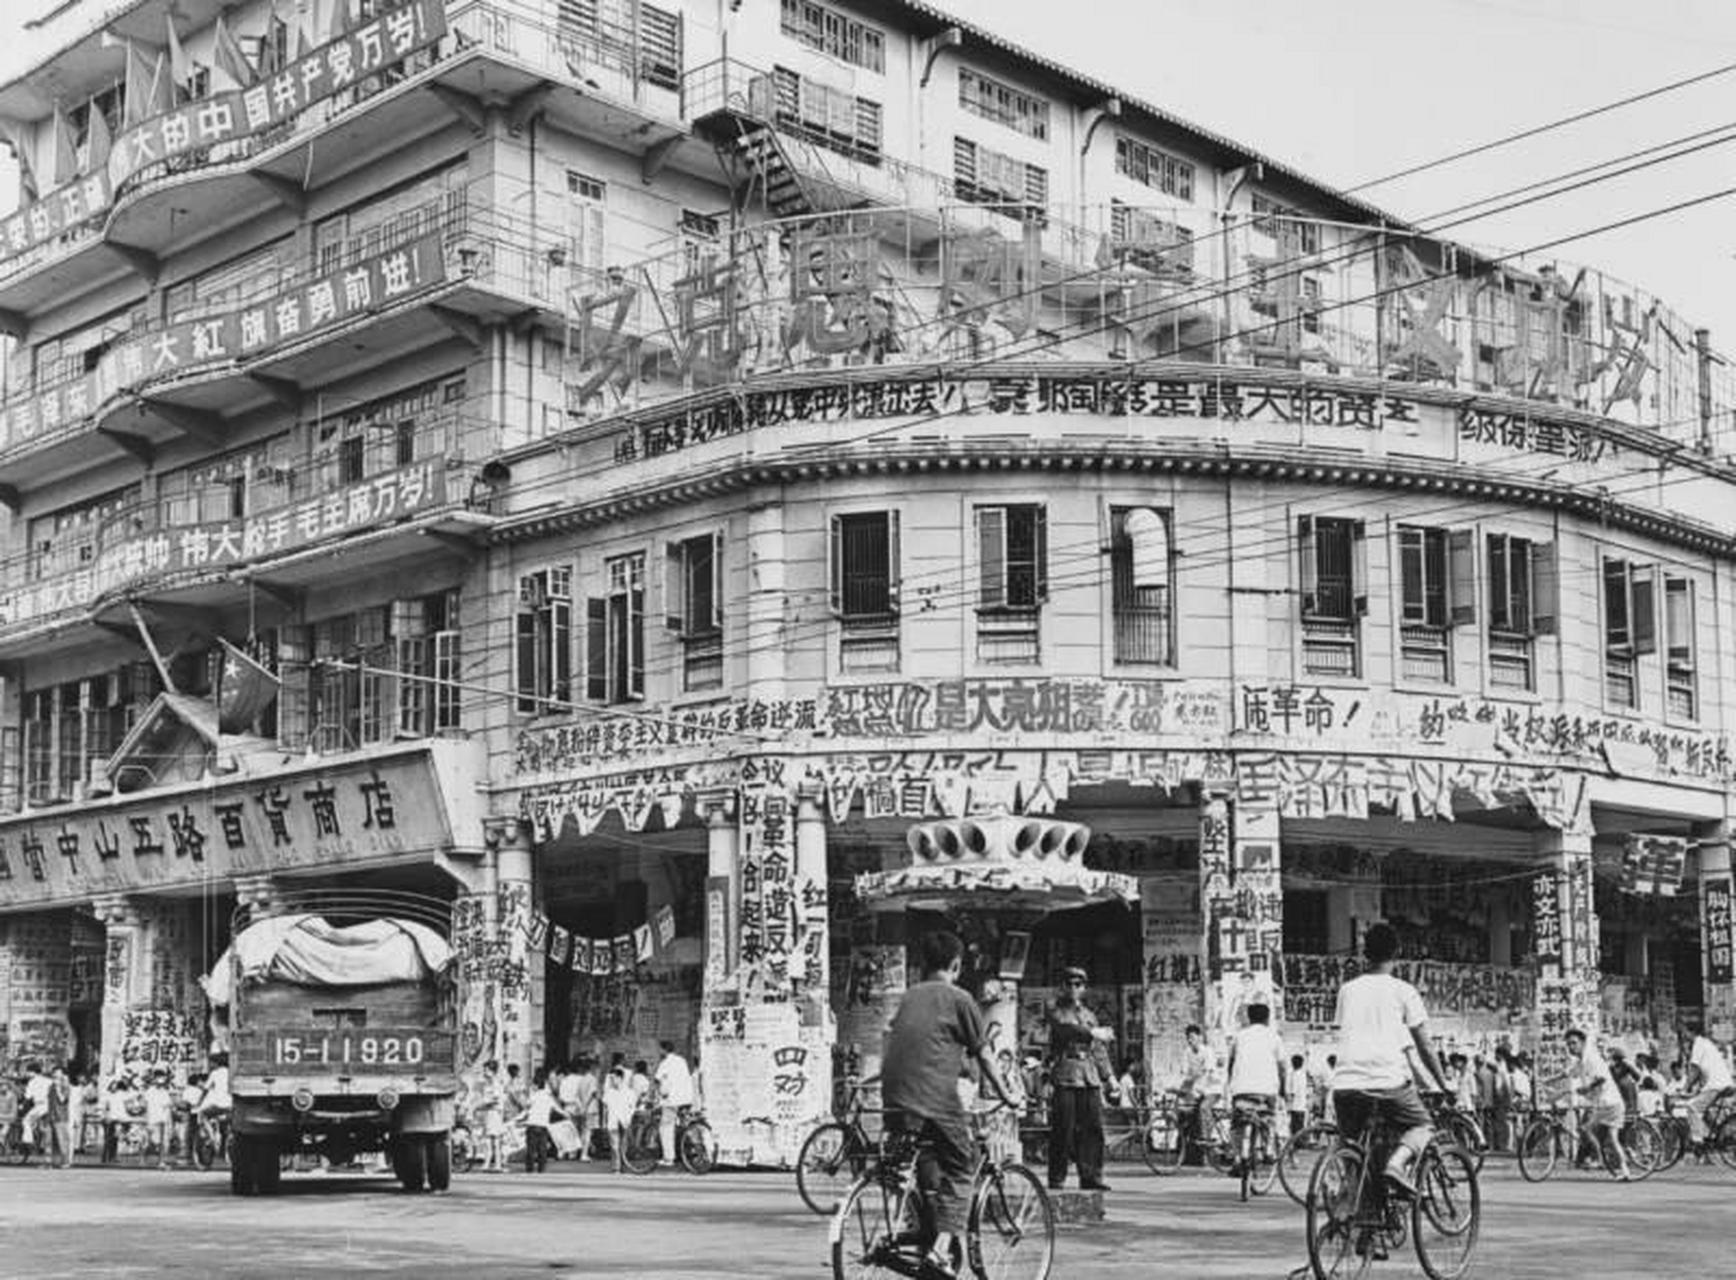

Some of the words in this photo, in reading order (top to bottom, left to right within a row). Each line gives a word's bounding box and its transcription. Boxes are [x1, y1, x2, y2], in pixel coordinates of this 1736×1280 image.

[1242, 684, 1360, 736] 闹革命!
[275, 1037, 424, 1065] 15-11920
